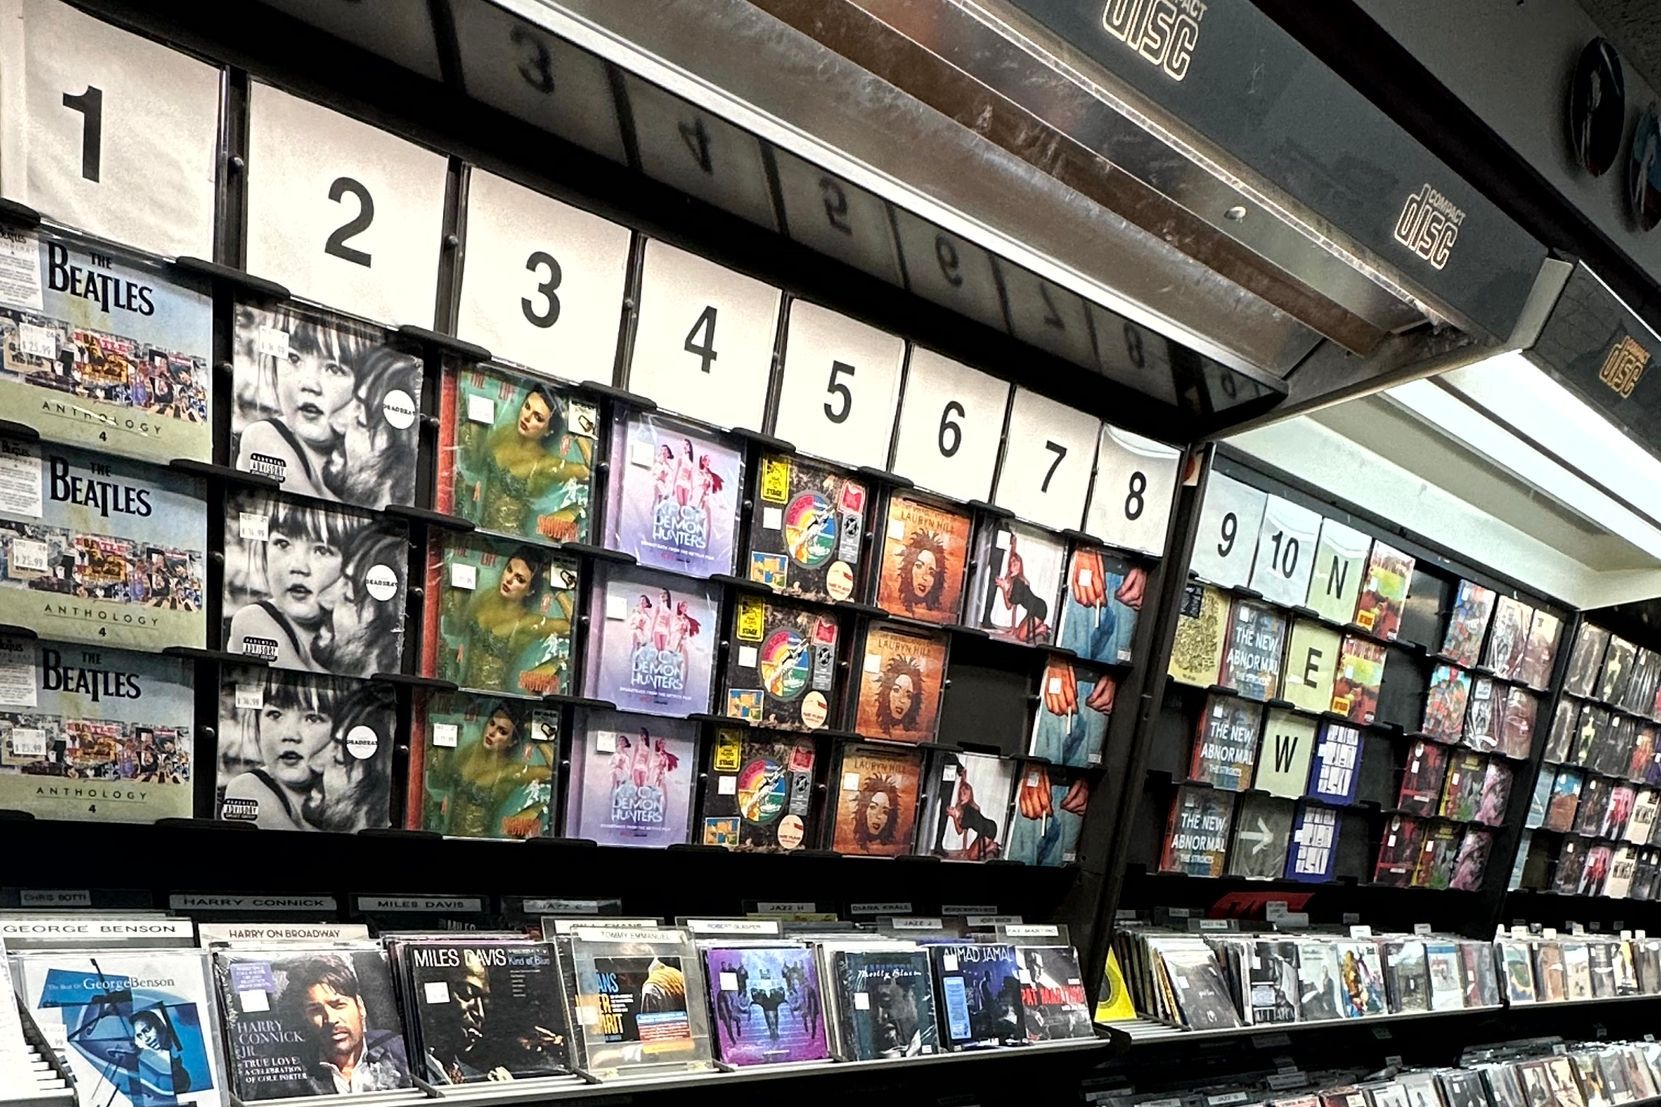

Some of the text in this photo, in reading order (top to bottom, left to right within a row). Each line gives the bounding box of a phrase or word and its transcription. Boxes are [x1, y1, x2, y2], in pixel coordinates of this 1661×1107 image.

[62, 85, 102, 183] 1
[1429, 189, 1466, 226] COMPACT
[324, 177, 375, 268] 2
[91, 252, 112, 270] THE
[47, 240, 155, 316] BEATLES
[521, 251, 562, 328] 3
[684, 305, 718, 374] 4
[824, 360, 857, 424] 5
[99, 431, 108, 442] 4
[938, 400, 965, 458] 6
[90, 462, 112, 478] THE
[1041, 440, 1067, 493] 7
[49, 456, 152, 518] BEATLES
[1124, 471, 1147, 521] 8
[1218, 512, 1237, 557] 9
[1271, 530, 1299, 579] 10
[1328, 555, 1348, 599] N
[44, 603, 159, 626] ANTHOLOGY
[99, 627, 106, 637] 4
[1235, 626, 1278, 652] THE NEW
[82, 651, 102, 666] THE
[1226, 649, 1279, 674] ABNORMAL
[1304, 647, 1323, 688] E
[41, 648, 142, 702] BEATLES
[630, 672, 683, 691] HUNTERS
[1210, 721, 1254, 743] THE NEW
[1200, 744, 1254, 766] ABNORMAL
[1275, 735, 1298, 774] W
[36, 786, 147, 801] ANTHOLOGY
[88, 805, 96, 813] 4
[611, 808, 663, 823] HUNTERS
[1181, 812, 1226, 832] THE NEW
[1171, 833, 1225, 853] ABNORMAL
[183, 897, 325, 907] HARRY CONNICK
[378, 900, 465, 909] MILES DAVIS
[4, 924, 176, 933] GEORGE BENSON
[229, 929, 341, 939] HARRY ON BROADWAY
[414, 948, 507, 968] MILES DAVIS
[237, 1020, 283, 1033] HARRY
[239, 1031, 305, 1045] CONNICK
[240, 1045, 256, 1058] JR
[243, 1057, 300, 1069] TRUE LOVE
